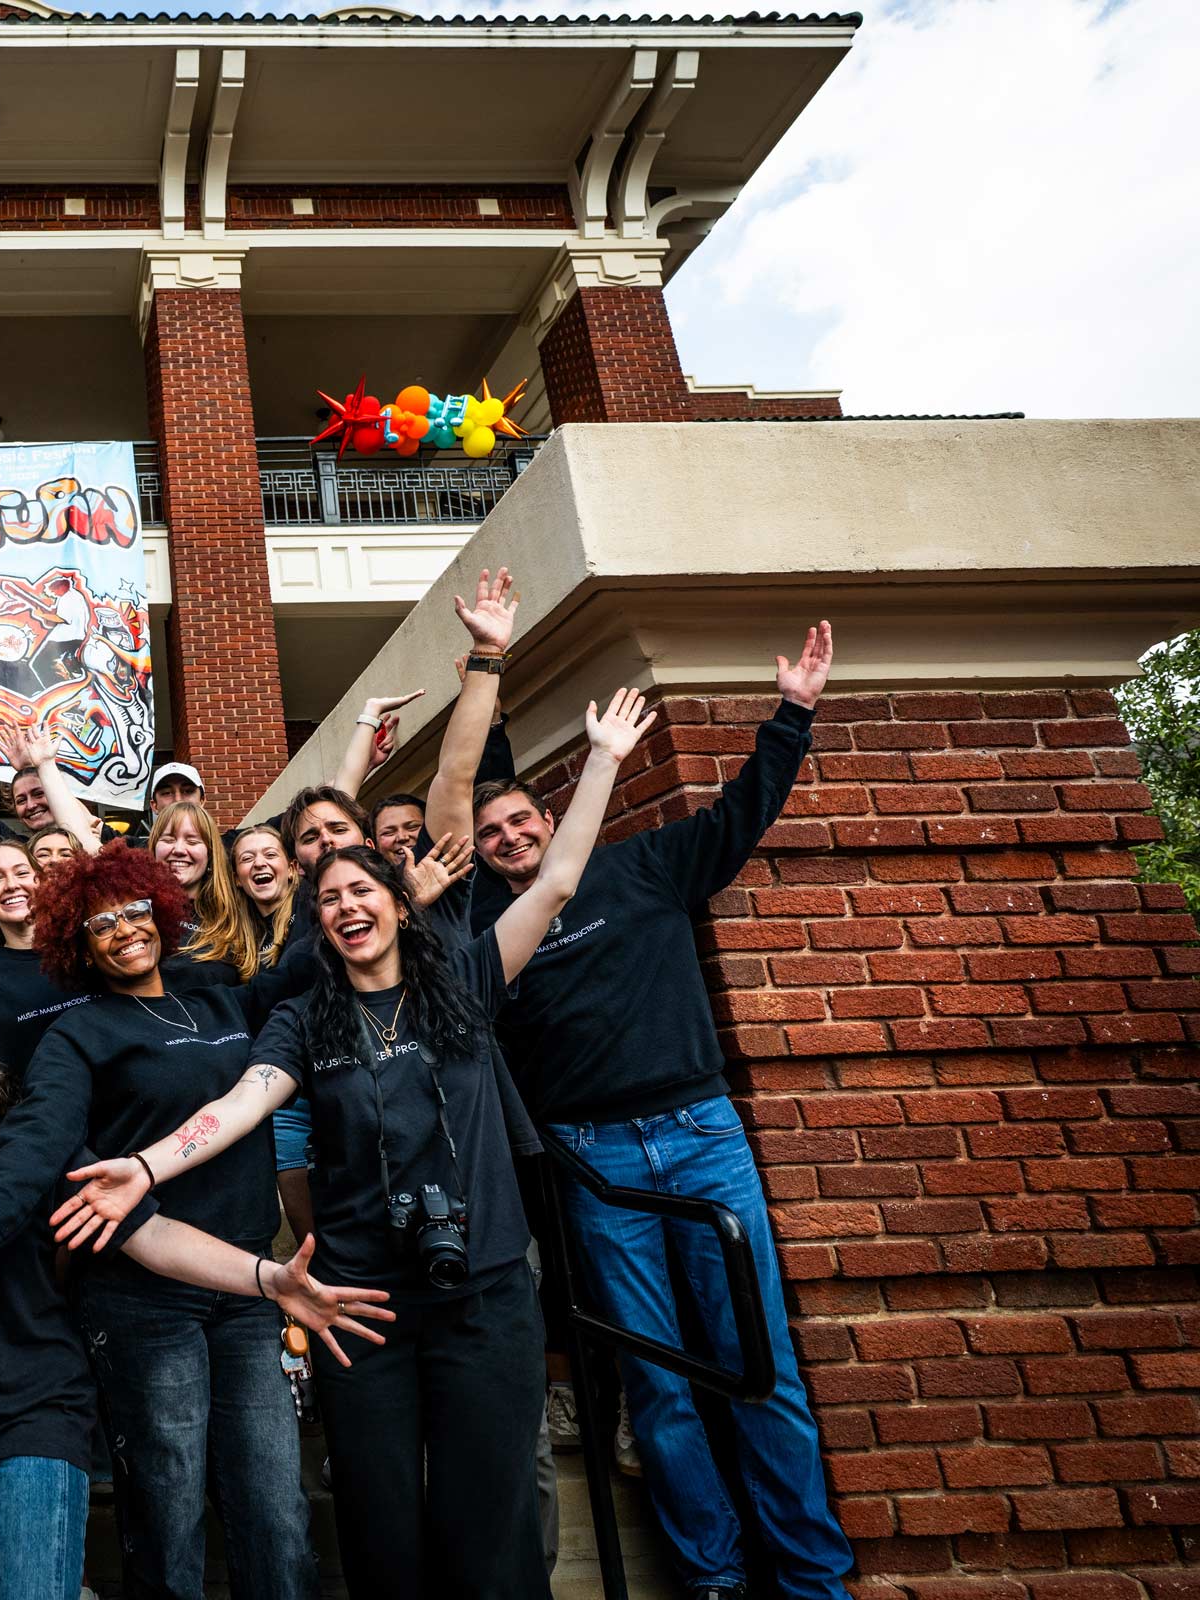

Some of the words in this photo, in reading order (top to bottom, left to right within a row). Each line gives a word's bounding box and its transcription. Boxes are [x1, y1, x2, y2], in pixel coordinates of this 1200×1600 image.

[558, 918, 606, 946] PRODUCTIONS
[17, 1010, 39, 1022] MUSIC
[39, 1003, 62, 1015] MAKER
[62, 994, 91, 1009] PRODUC
